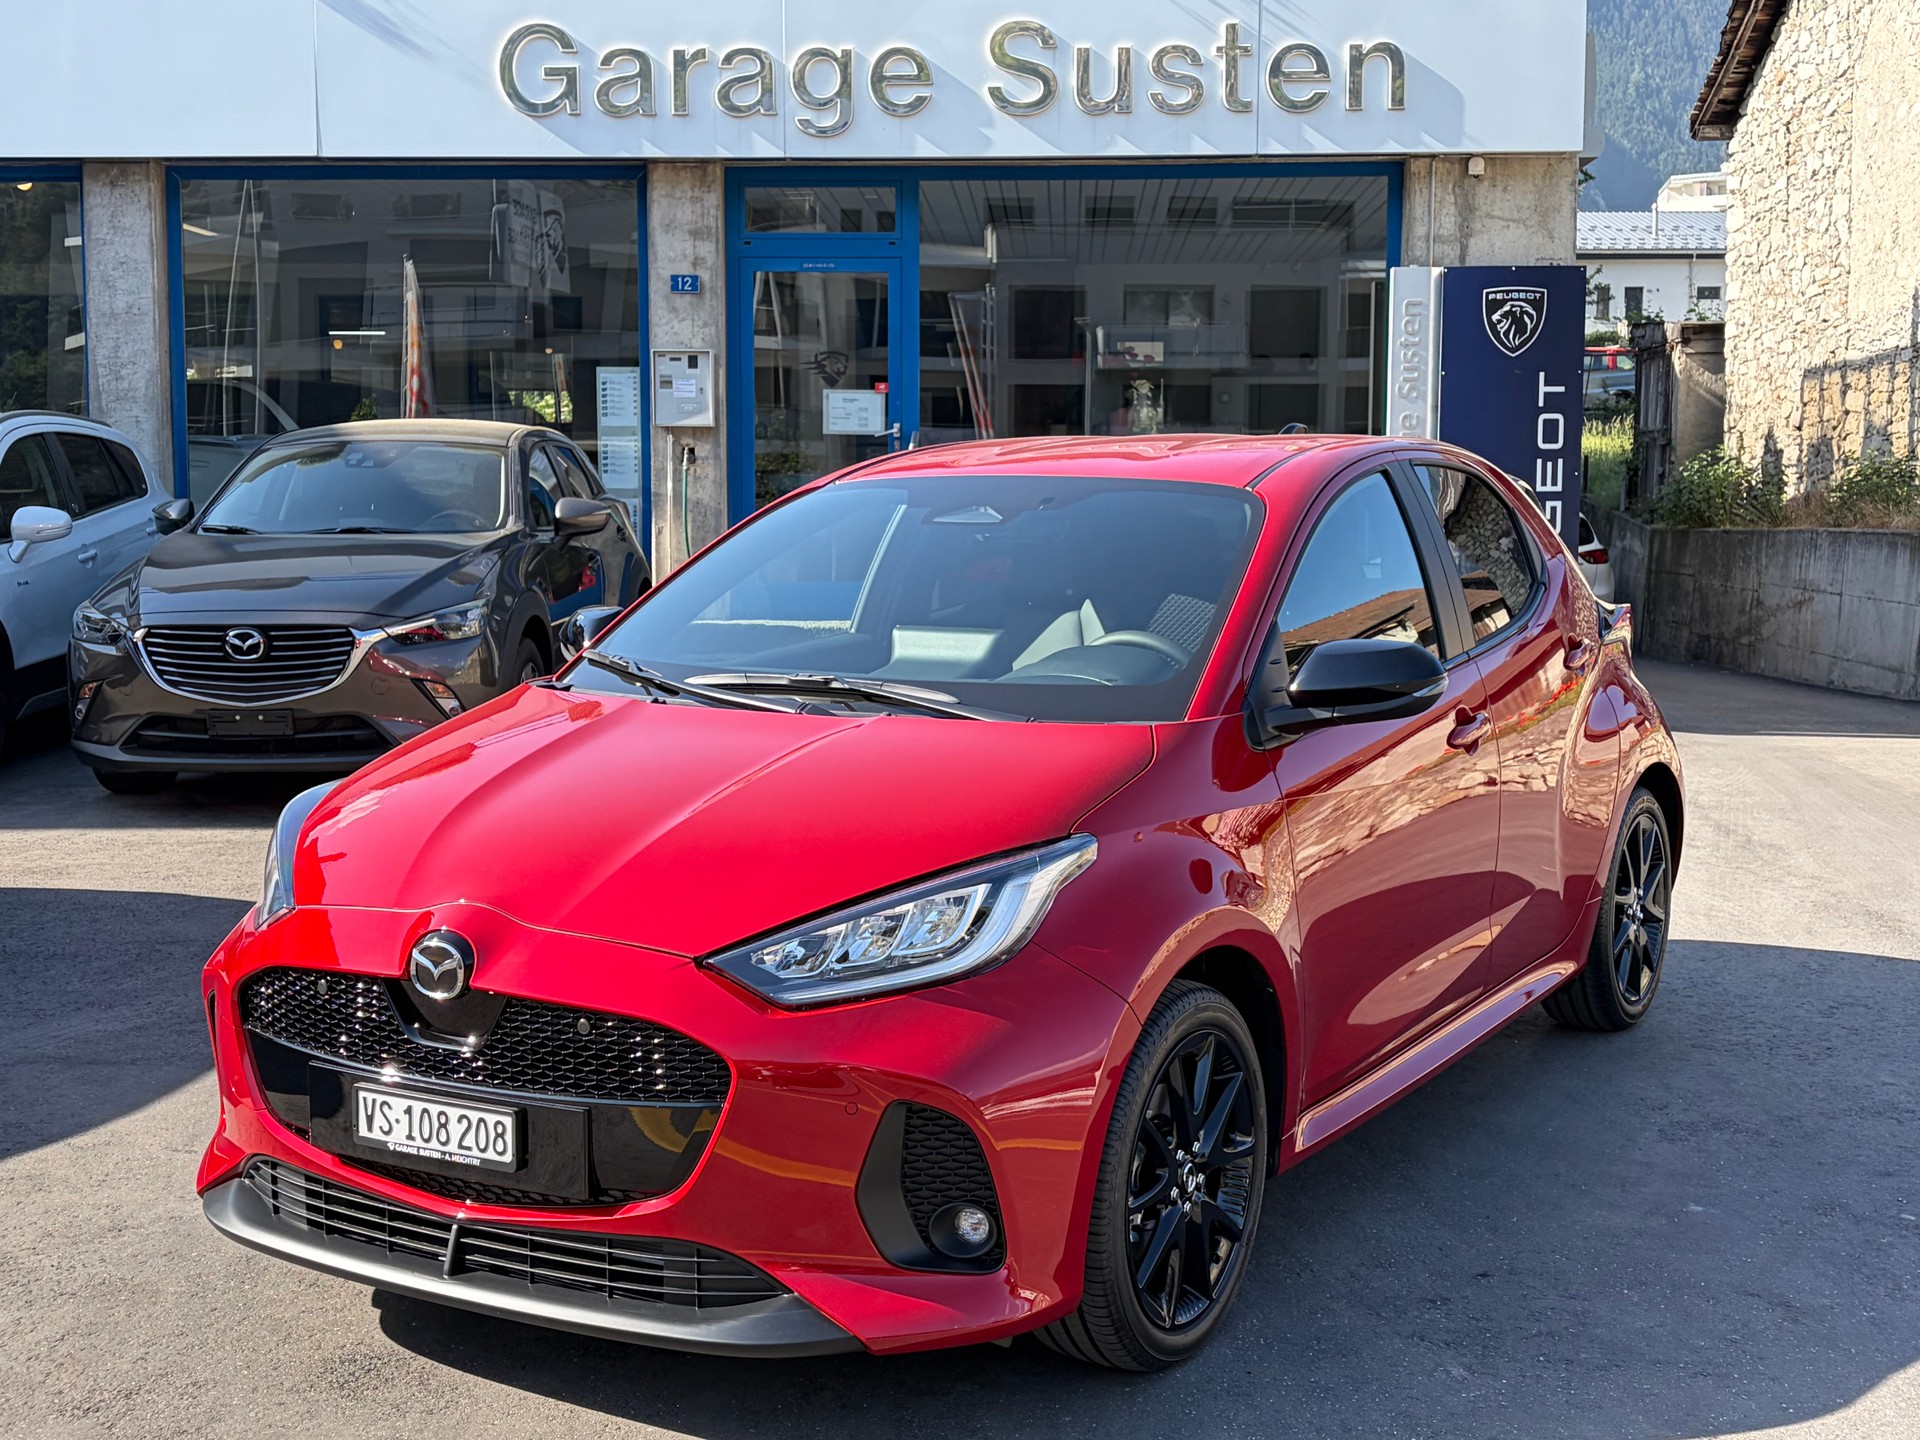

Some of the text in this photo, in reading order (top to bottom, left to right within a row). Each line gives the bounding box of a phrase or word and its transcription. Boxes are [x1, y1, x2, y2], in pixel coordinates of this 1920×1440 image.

[498, 19, 1406, 137] Garage Susten
[677, 276, 692, 290] 12
[1489, 292, 1541, 300] PEUGEOT
[1396, 298, 1422, 401] Susten
[395, 1144, 418, 1155] GARAGE
[419, 1148, 442, 1159] SUSTEN
